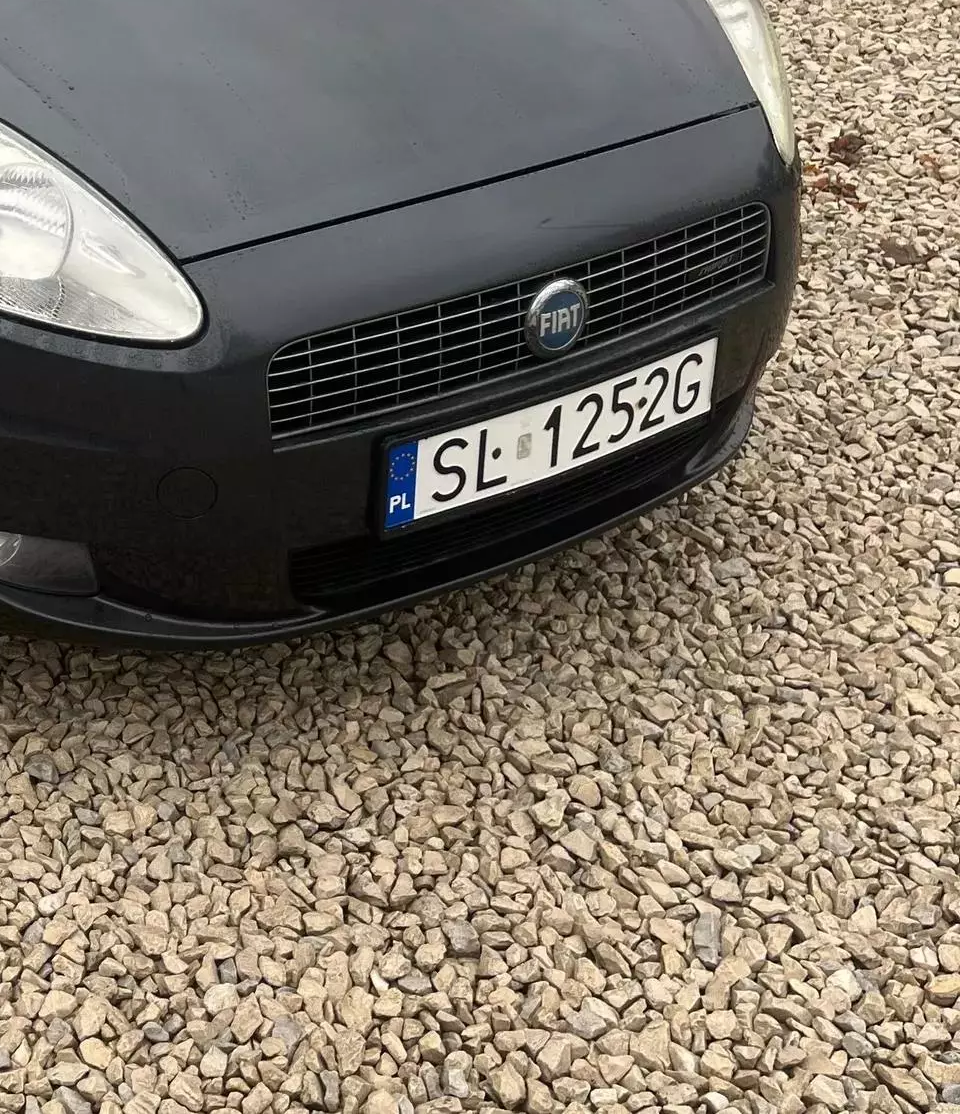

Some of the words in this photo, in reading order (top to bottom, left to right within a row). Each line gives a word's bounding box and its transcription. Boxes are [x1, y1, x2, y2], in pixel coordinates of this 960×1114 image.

[540, 303, 581, 338] FIAT
[431, 428, 507, 503] SL
[543, 353, 703, 468] 1252G
[389, 492, 411, 514] PL
